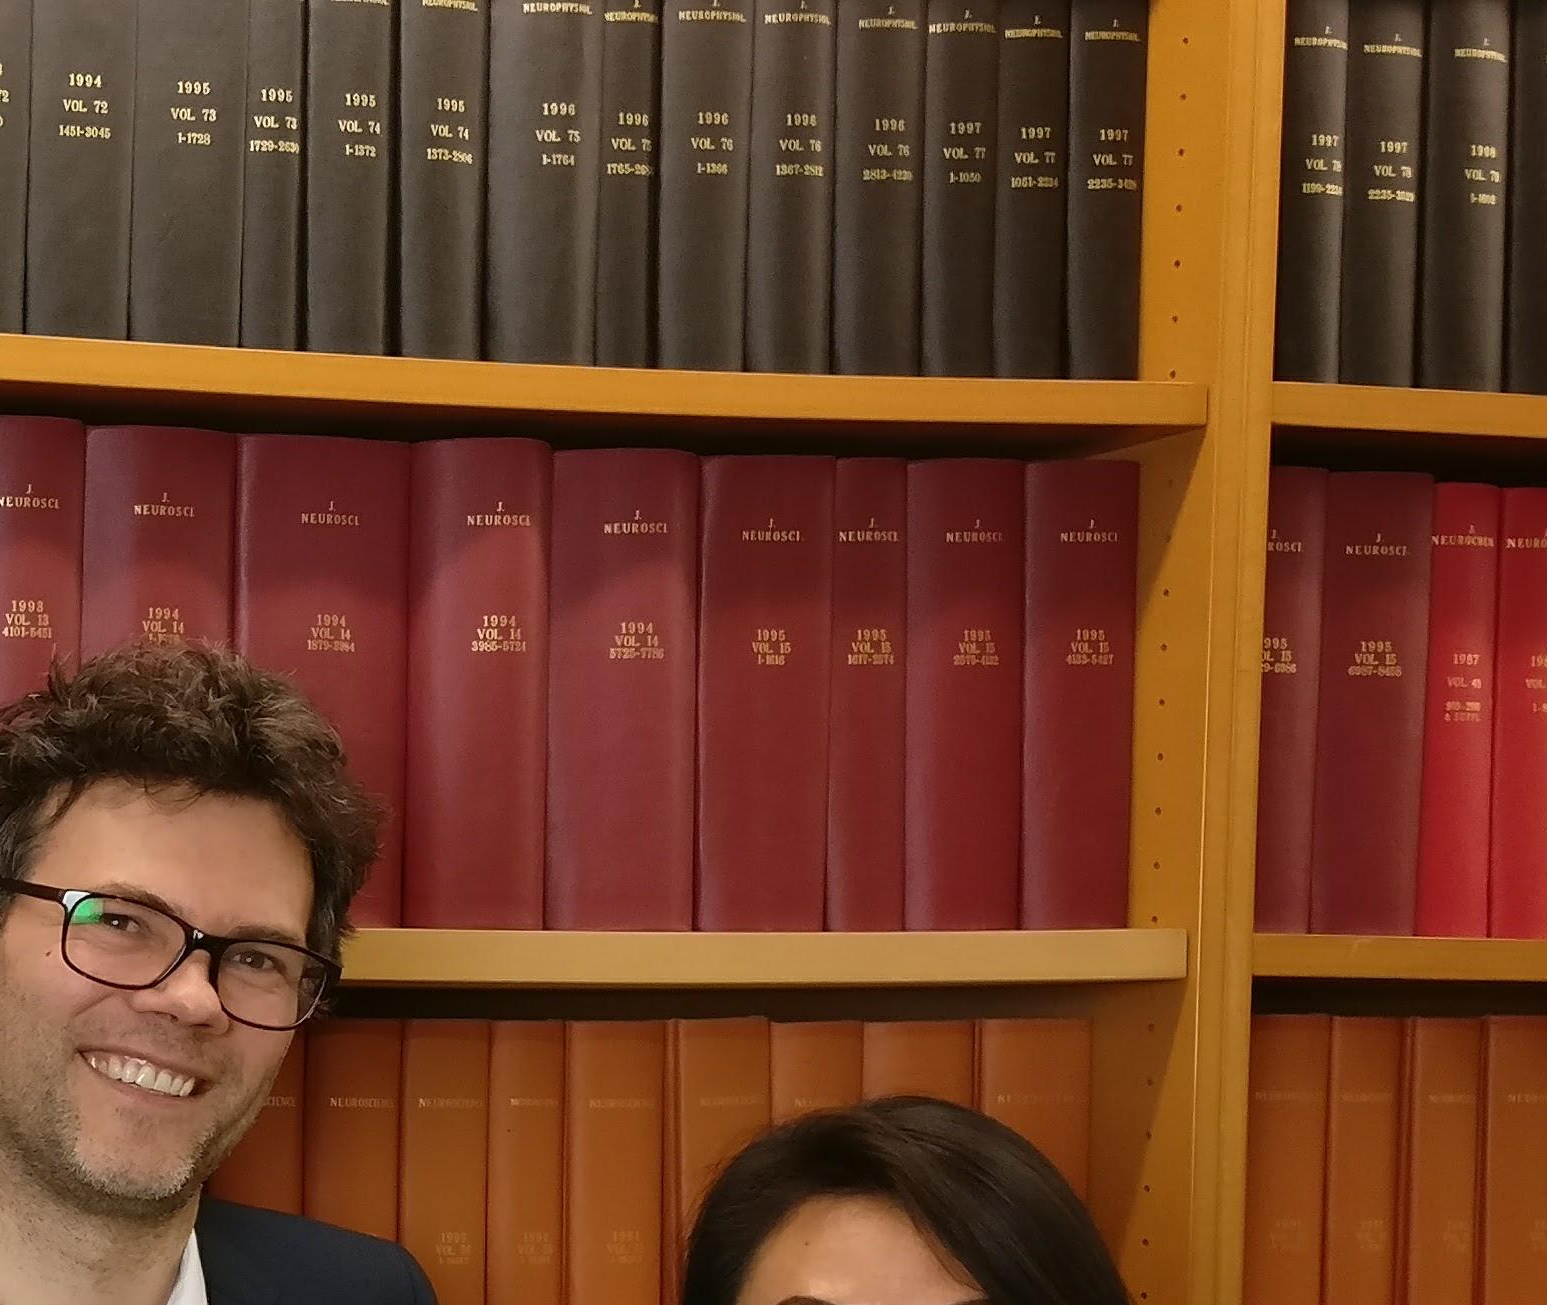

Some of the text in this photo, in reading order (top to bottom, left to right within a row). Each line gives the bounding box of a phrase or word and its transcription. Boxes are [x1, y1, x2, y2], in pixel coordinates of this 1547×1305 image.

[69, 73, 101, 88] 1994
[177, 81, 210, 95] 1995
[345, 93, 376, 107] 1995
[94, 100, 108, 114] 72
[202, 109, 216, 122] 73
[367, 121, 381, 134] 74
[950, 122, 981, 135] 1997
[11, 600, 43, 613] 1993
[148, 607, 179, 620] 1994
[173, 621, 184, 633] 14
[483, 615, 516, 628] 1994
[620, 622, 654, 634] 1994
